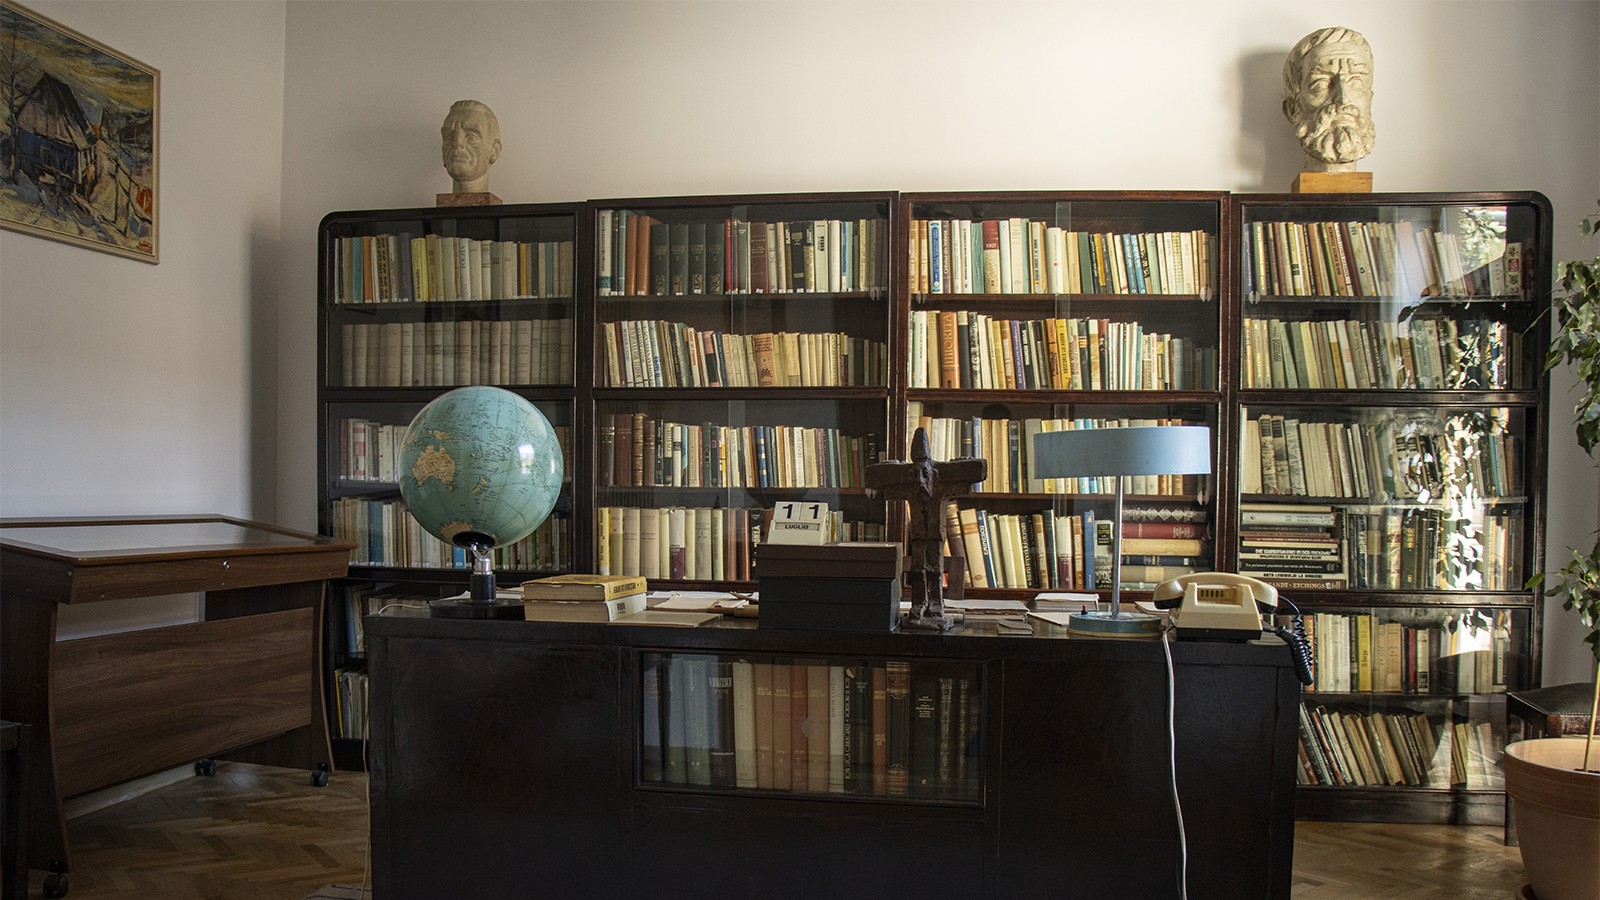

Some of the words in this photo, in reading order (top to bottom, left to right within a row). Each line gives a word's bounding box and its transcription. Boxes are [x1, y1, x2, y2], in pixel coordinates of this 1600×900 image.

[782, 504, 792, 520] 1
[808, 504, 819, 520] 1
[980, 524, 989, 556] EMINESCU
[1358, 530, 1366, 553] HOREA
